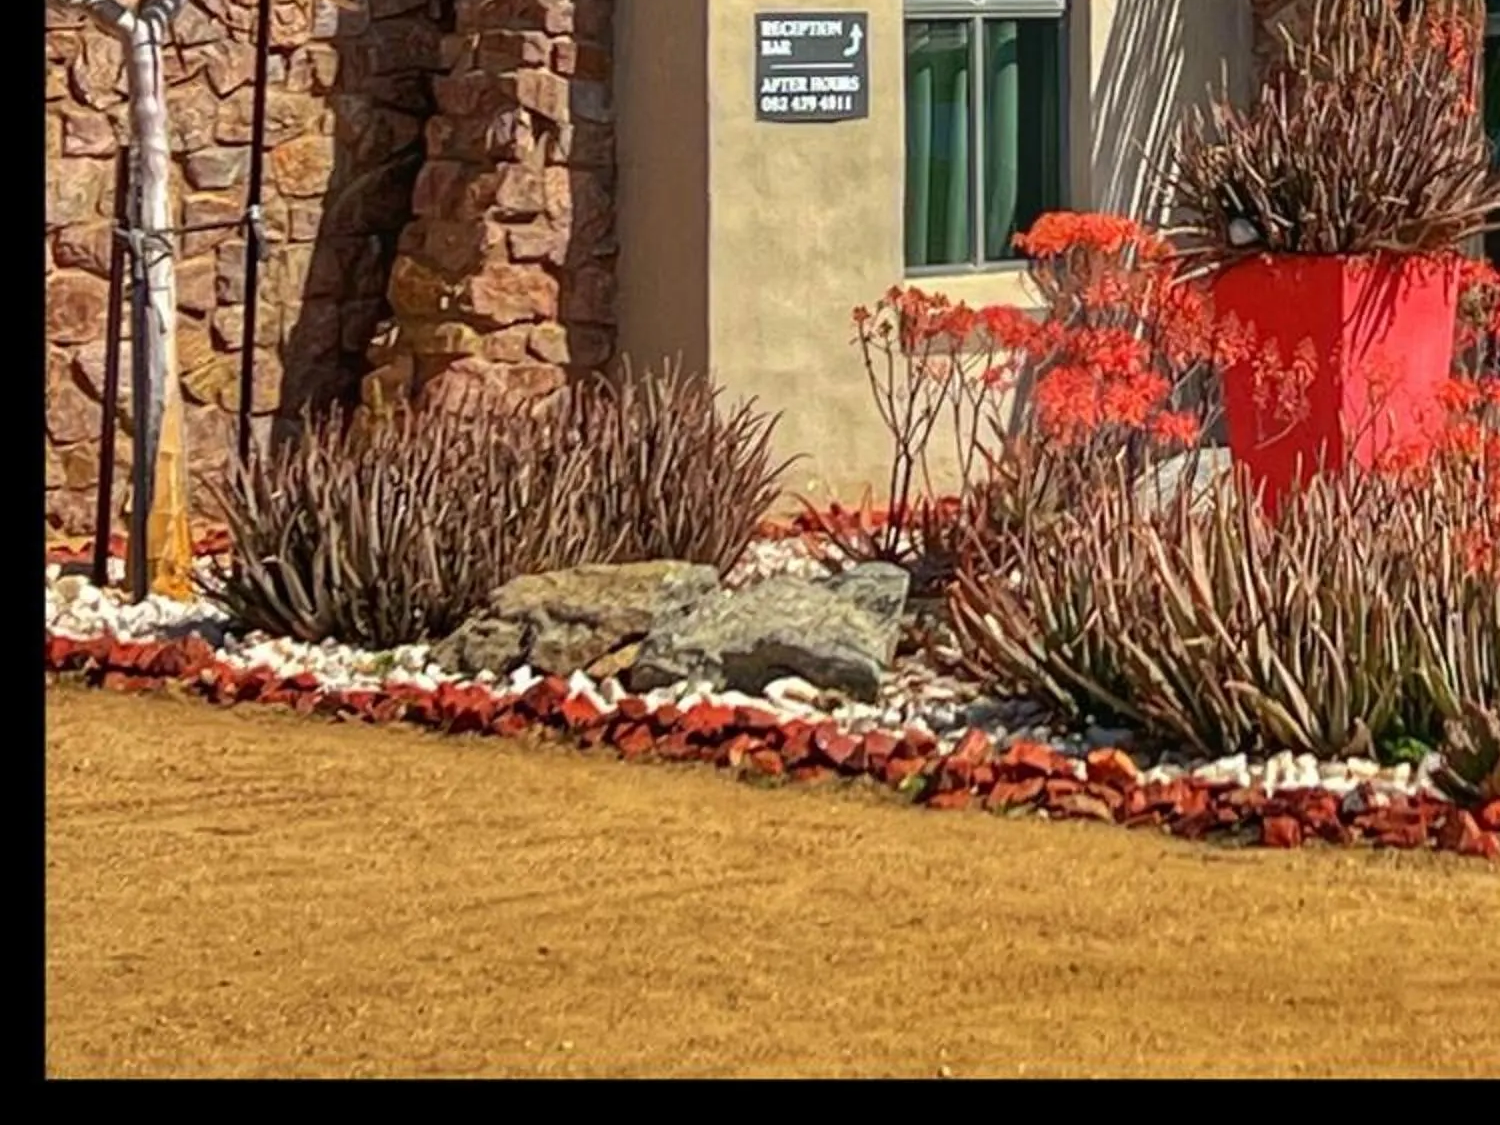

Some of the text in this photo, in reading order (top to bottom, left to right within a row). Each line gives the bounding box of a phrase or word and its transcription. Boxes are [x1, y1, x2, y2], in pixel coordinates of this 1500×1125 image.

[760, 20, 842, 37] RECEPTION
[761, 39, 792, 56] BAR
[761, 75, 860, 93] AFTER HOURS
